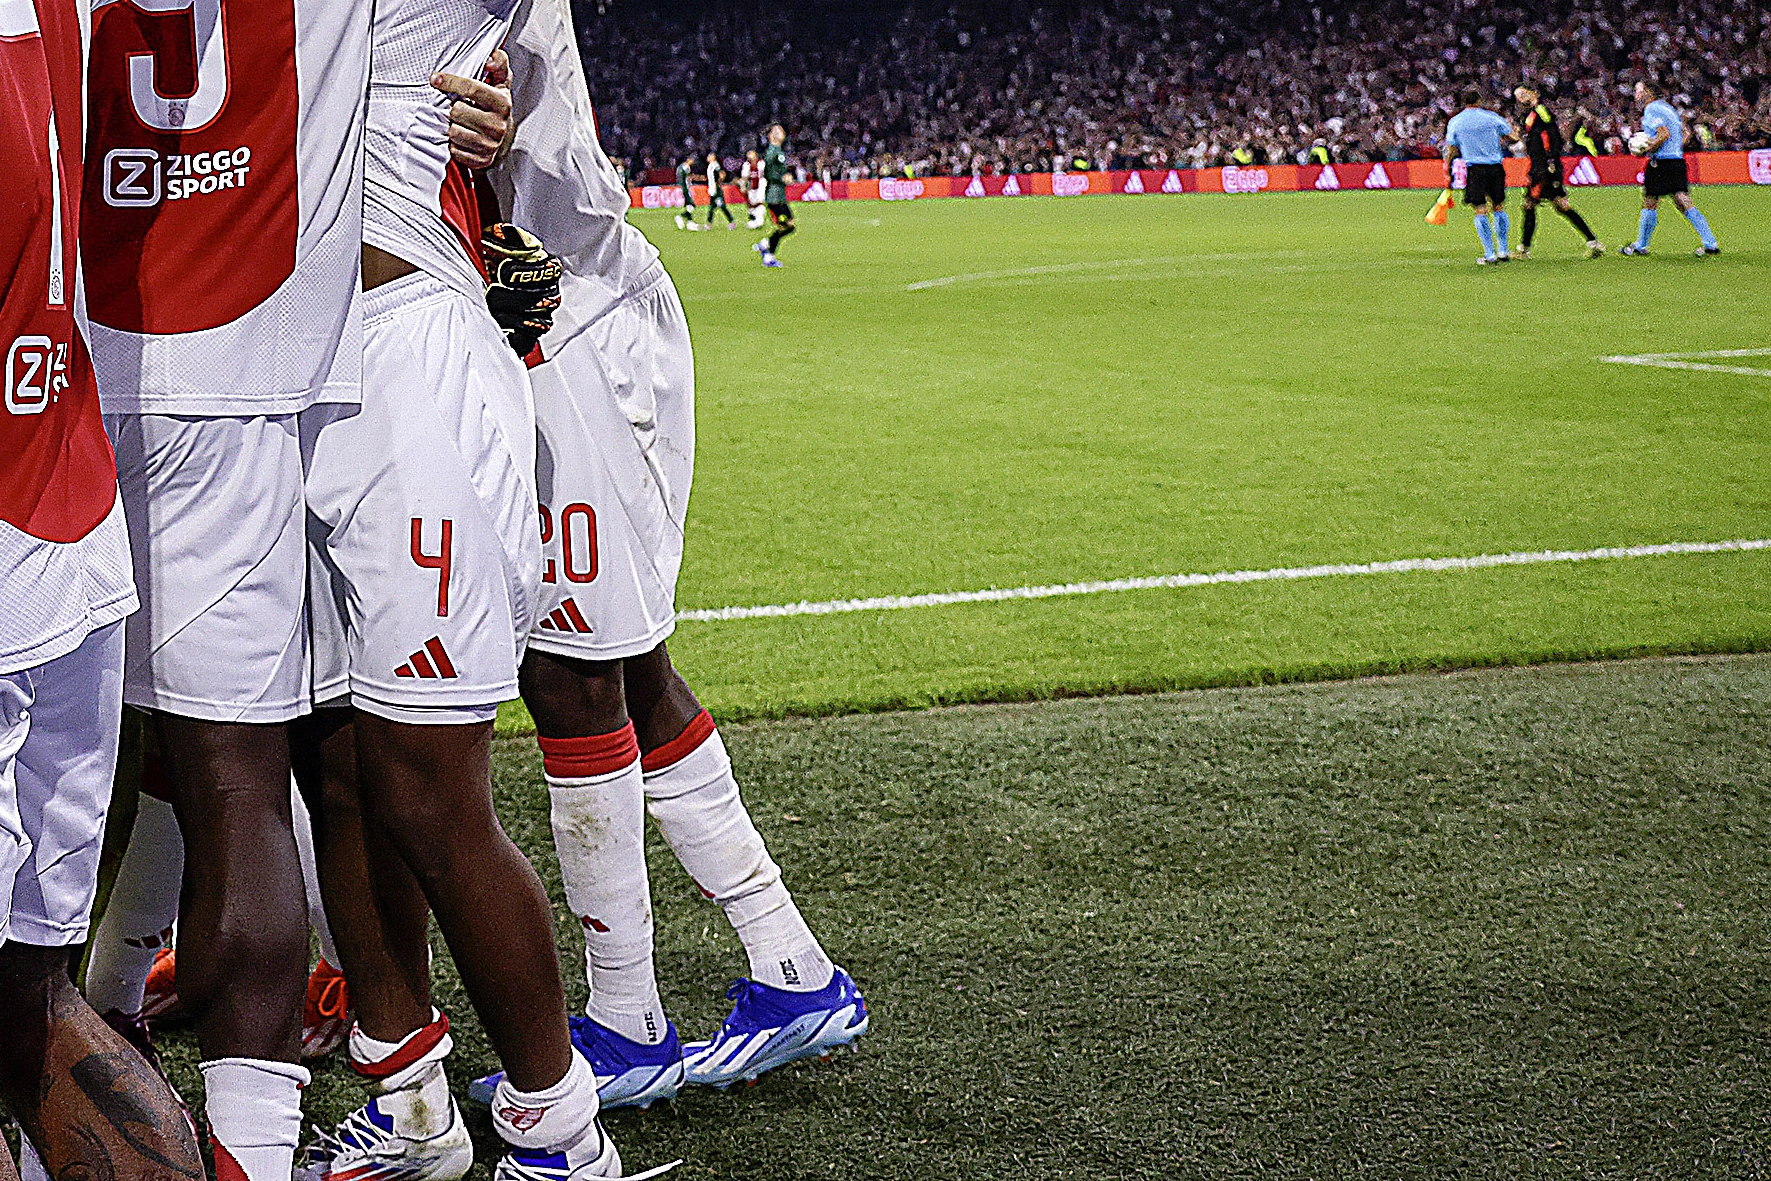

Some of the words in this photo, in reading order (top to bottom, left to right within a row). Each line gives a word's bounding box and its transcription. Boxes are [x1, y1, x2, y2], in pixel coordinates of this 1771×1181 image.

[166, 146, 251, 177] ZIGGO
[166, 166, 250, 200] SPORT
[411, 518, 453, 617] 4
